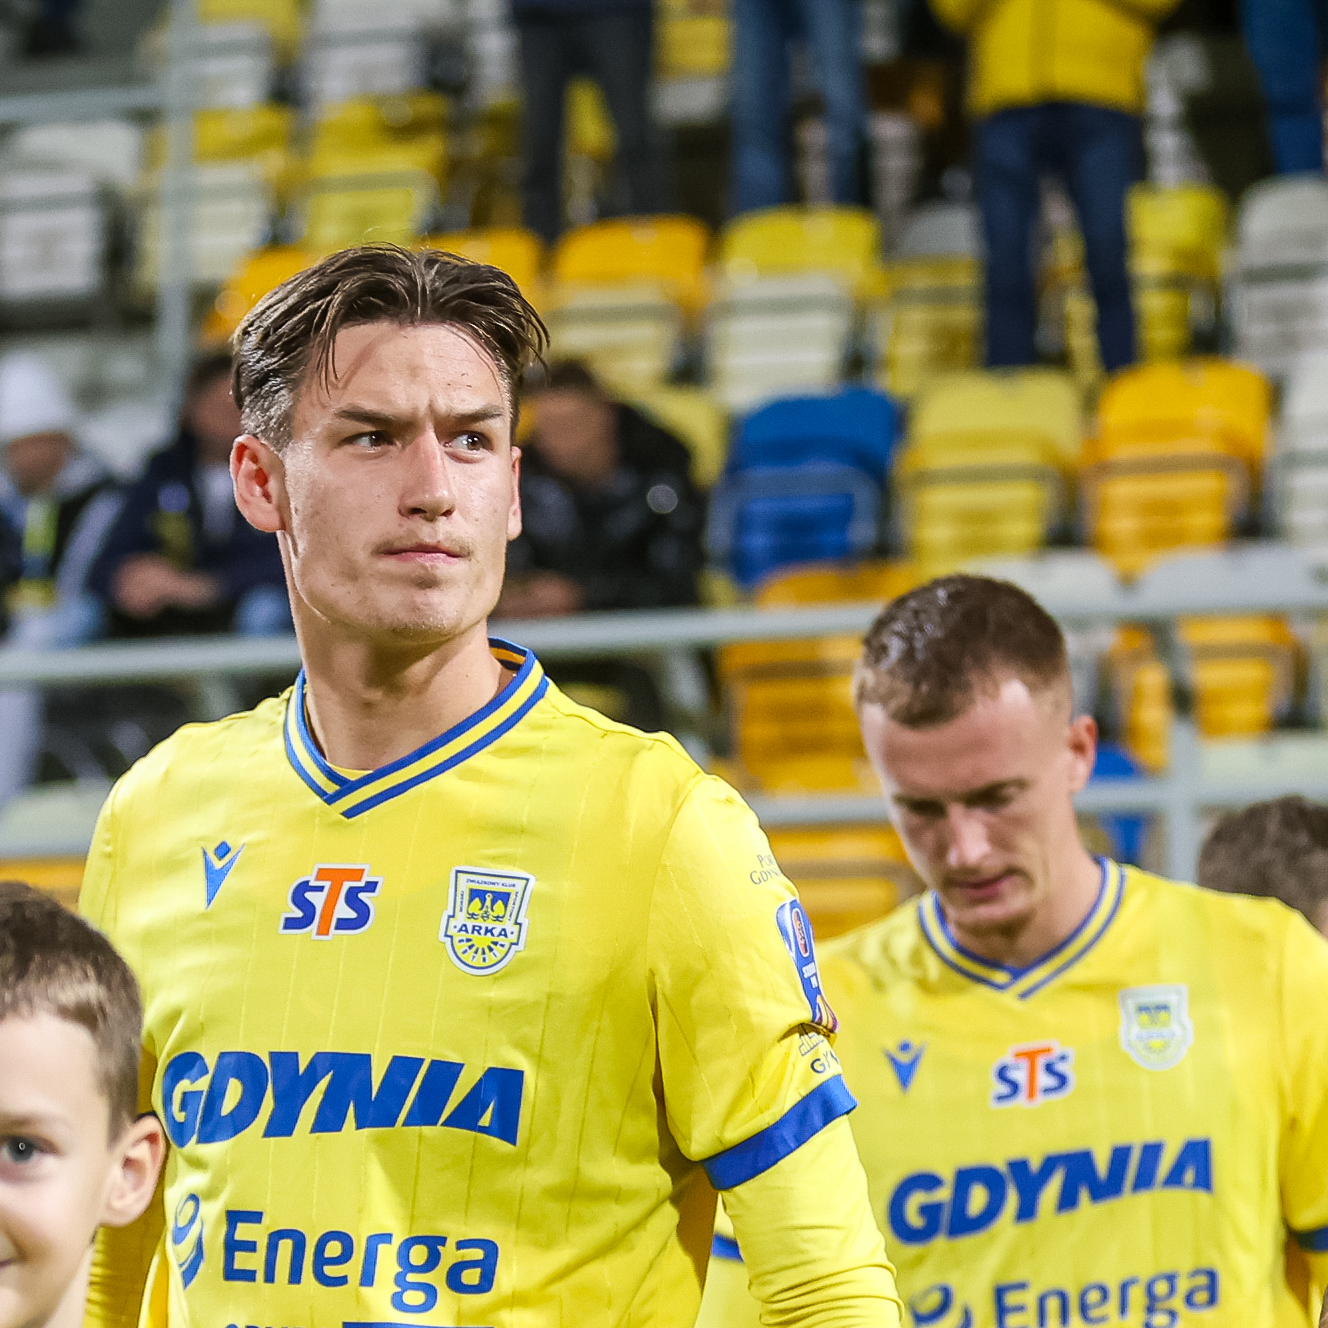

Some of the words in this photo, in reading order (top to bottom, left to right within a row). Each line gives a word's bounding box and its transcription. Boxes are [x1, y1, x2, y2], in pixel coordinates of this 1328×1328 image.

[282, 868, 379, 936] STS
[457, 923, 509, 938] ARKA
[162, 1051, 525, 1148] GDYNIA
[994, 1045, 1071, 1102] STS
[887, 1138, 1213, 1245] GDYNIA
[222, 1209, 499, 1314] Energa
